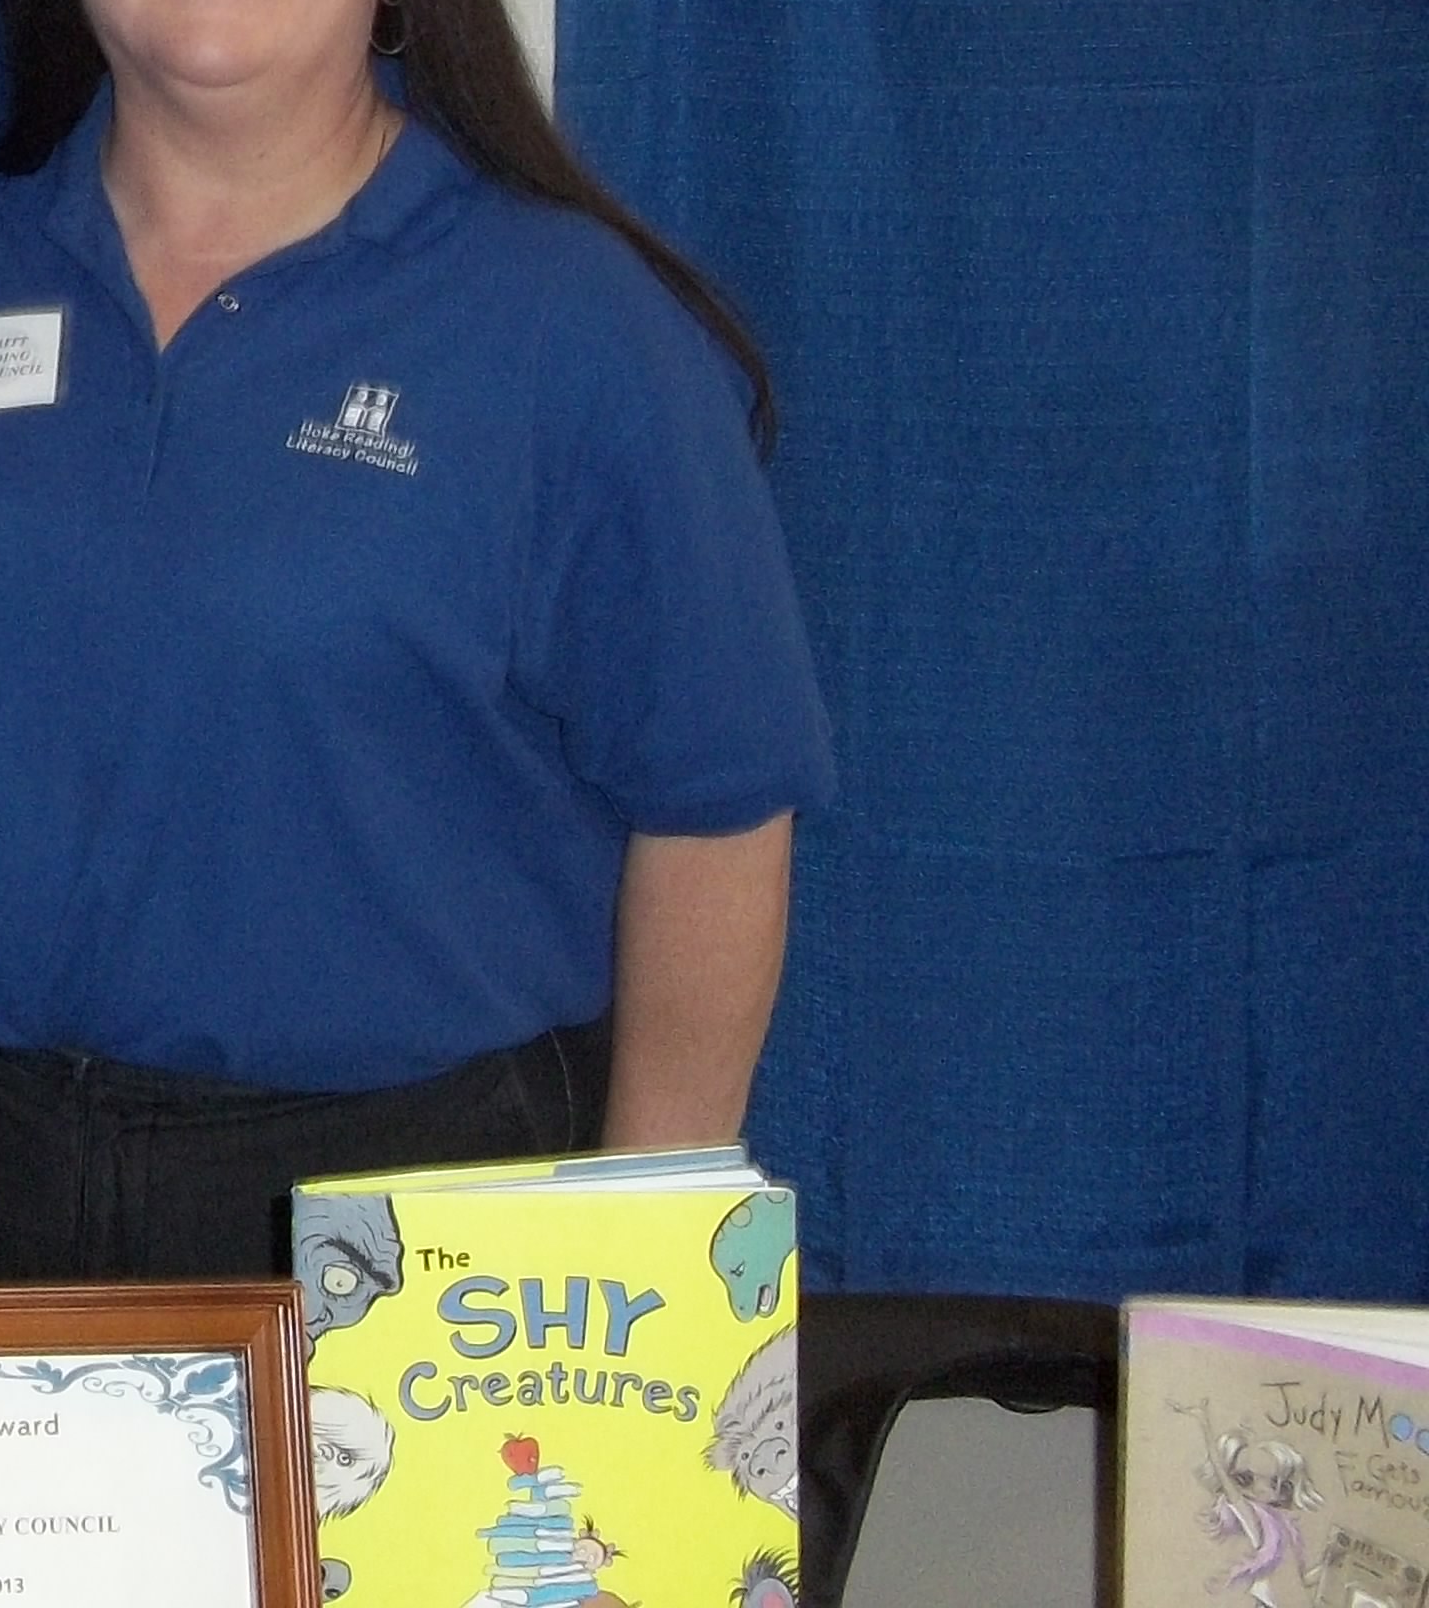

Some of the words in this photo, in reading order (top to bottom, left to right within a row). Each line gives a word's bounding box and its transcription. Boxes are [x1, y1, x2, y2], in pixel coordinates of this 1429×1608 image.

[300, 422, 340, 441] Hoke
[286, 434, 351, 460] Literacy
[355, 450, 418, 476] Council
[416, 1248, 470, 1272] The
[438, 1275, 666, 1359] SHY
[399, 1362, 700, 1422] Creatures
[1260, 1381, 1341, 1444] Judy
[1368, 1454, 1420, 1485] Gets
[14, 1514, 120, 1536] COUNCIL
